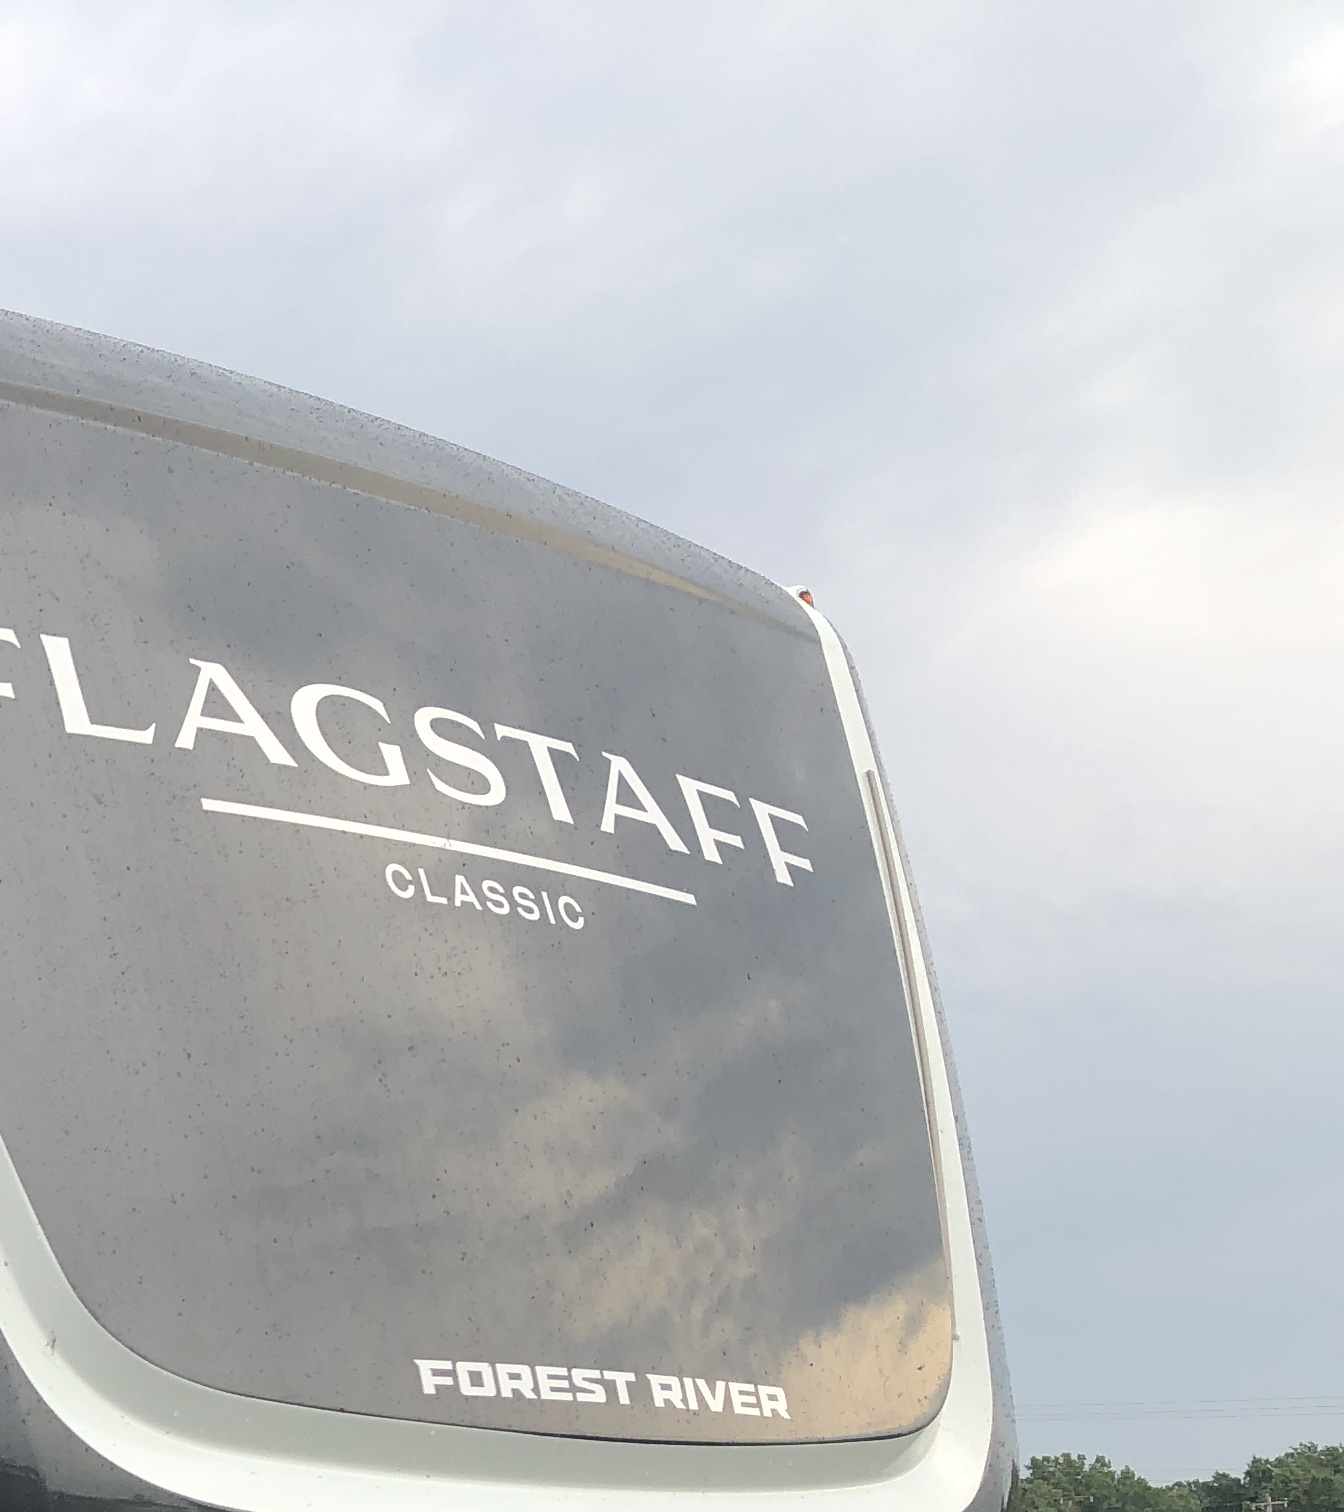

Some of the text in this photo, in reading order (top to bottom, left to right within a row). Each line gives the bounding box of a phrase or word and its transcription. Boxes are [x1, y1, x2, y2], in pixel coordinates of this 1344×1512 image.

[385, 861, 587, 932] CLASSIC
[413, 1359, 791, 1420] FOREST RIVER
